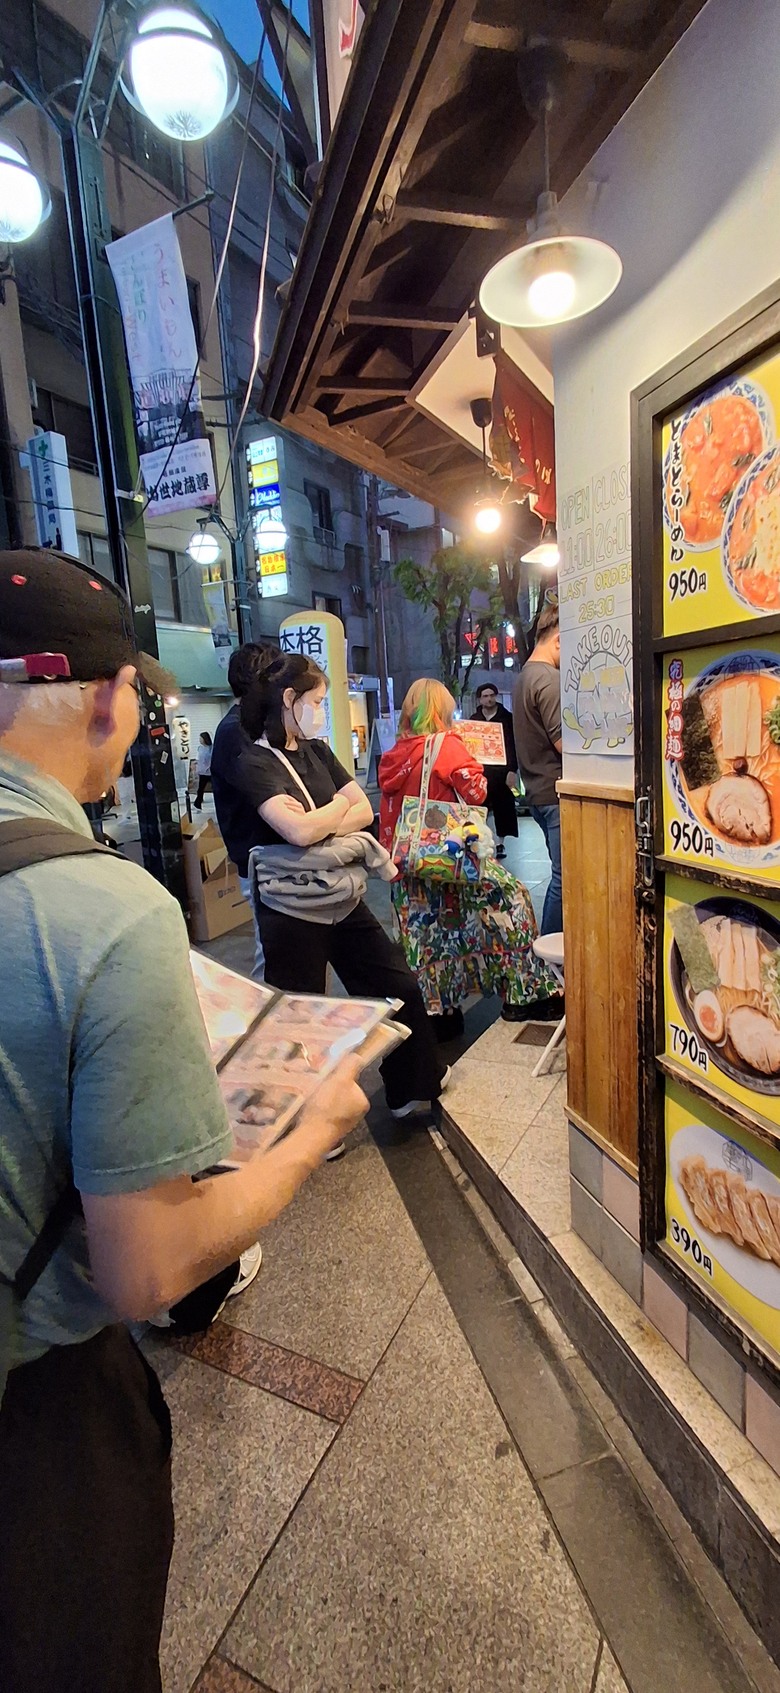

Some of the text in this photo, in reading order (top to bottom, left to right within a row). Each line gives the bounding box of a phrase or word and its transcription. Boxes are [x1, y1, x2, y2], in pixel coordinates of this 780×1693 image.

[154, 243, 182, 358] うまいもん
[560, 486, 590, 531] OPEN
[670, 419, 684, 561] とまとらーめん
[559, 528, 593, 577] 11:00
[559, 577, 588, 604] LAST
[669, 568, 707, 601] 950円
[578, 594, 615, 624] 25:30
[280, 625, 324, 656] 本格
[564, 624, 633, 693] TAKE OUT
[670, 820, 714, 857] 950円
[670, 1023, 707, 1072] 790円
[671, 1218, 713, 1277] 390円
